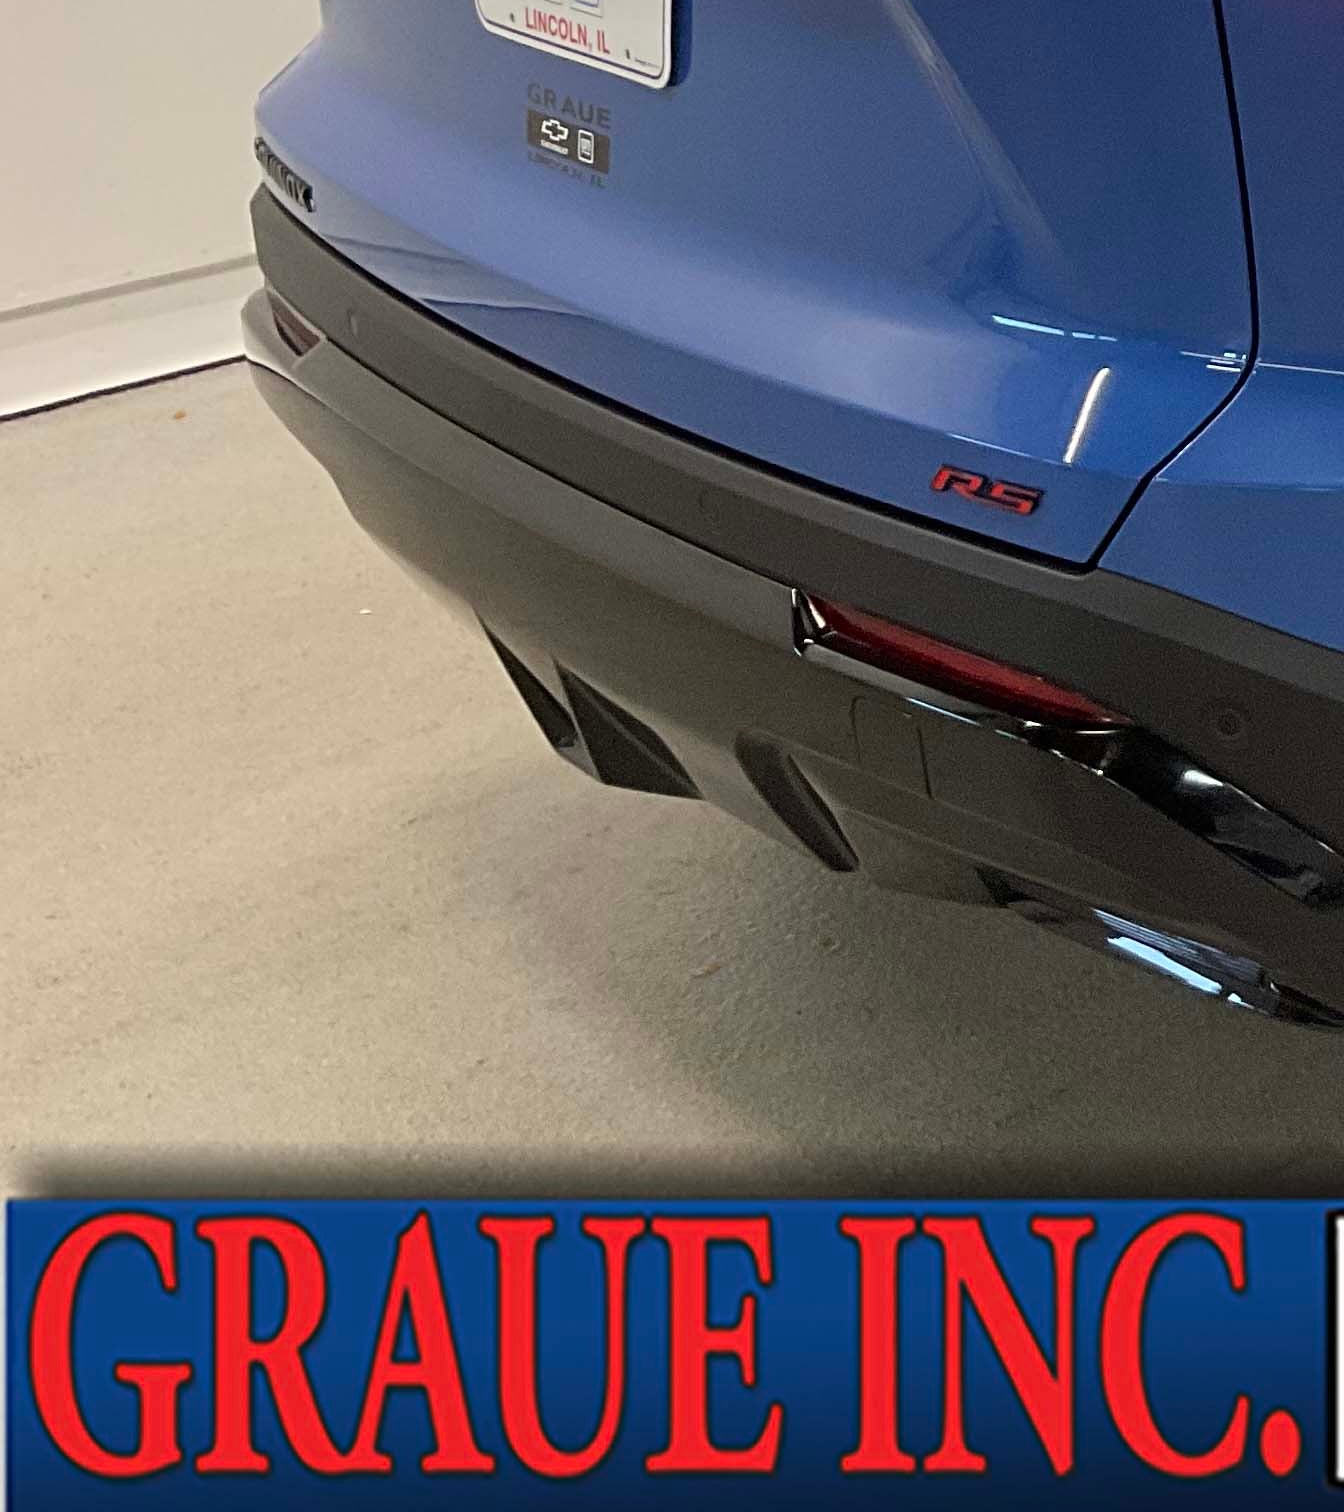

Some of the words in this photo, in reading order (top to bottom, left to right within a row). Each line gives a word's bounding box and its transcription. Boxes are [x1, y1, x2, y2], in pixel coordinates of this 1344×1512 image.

[525, 7, 592, 51] LINCOLN,
[596, 30, 611, 54] IL
[527, 83, 612, 131] GRAUE
[931, 464, 1046, 515] RS
